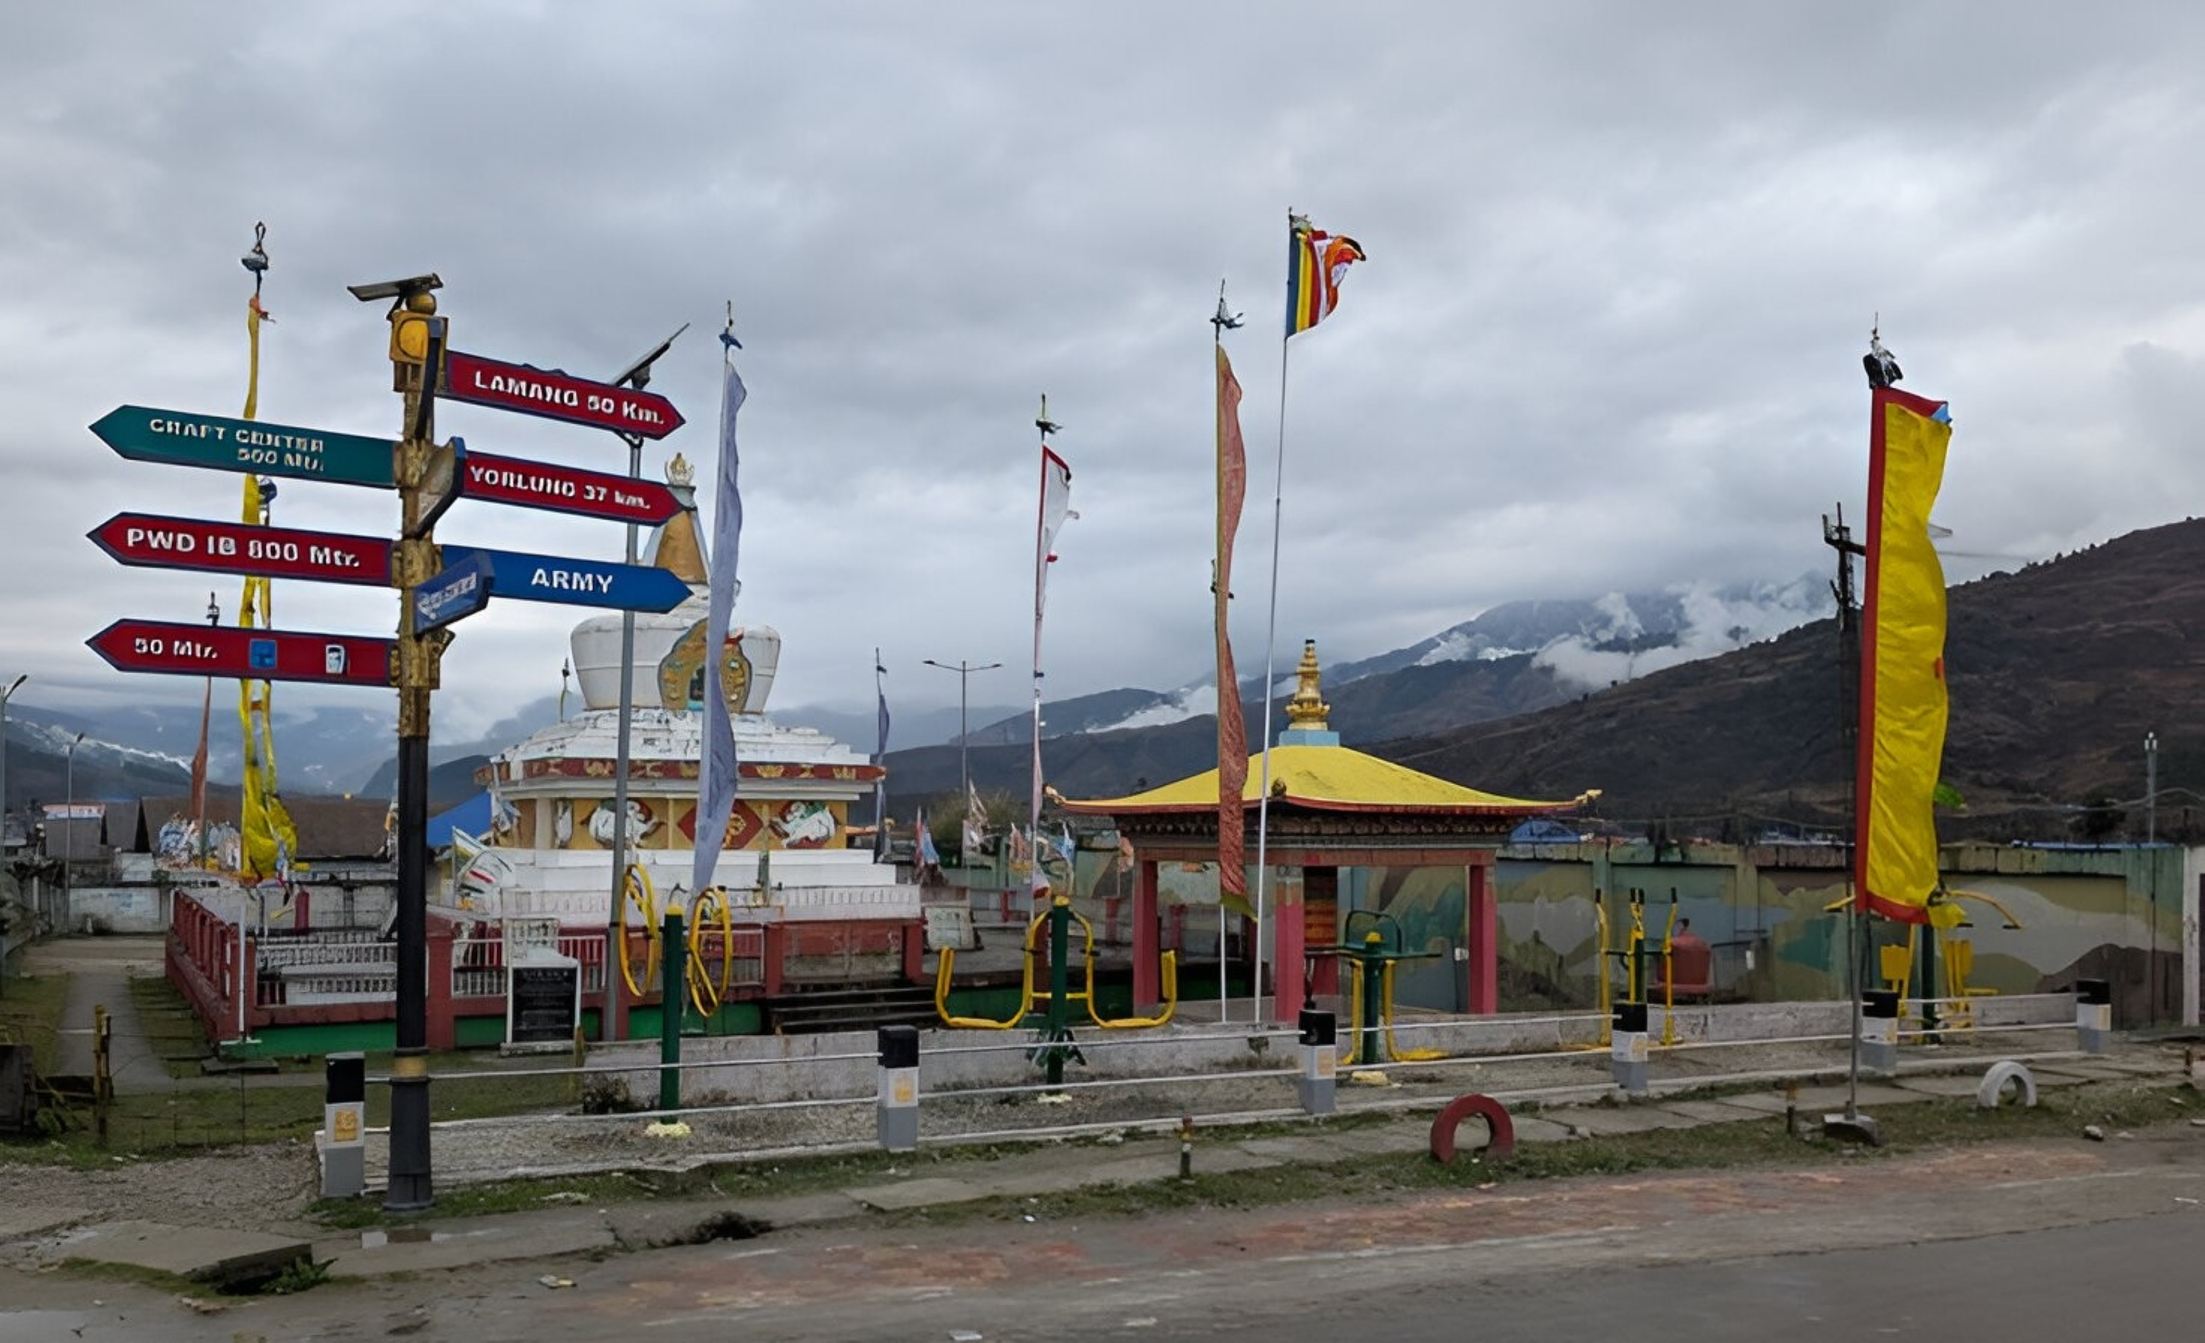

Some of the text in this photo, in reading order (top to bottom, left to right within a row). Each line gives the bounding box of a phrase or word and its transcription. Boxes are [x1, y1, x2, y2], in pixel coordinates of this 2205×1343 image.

[583, 484, 607, 501] 37
[127, 528, 195, 552] PWD
[248, 539, 299, 561] 800
[309, 546, 360, 567] Mtr.
[531, 568, 614, 593] ARMY
